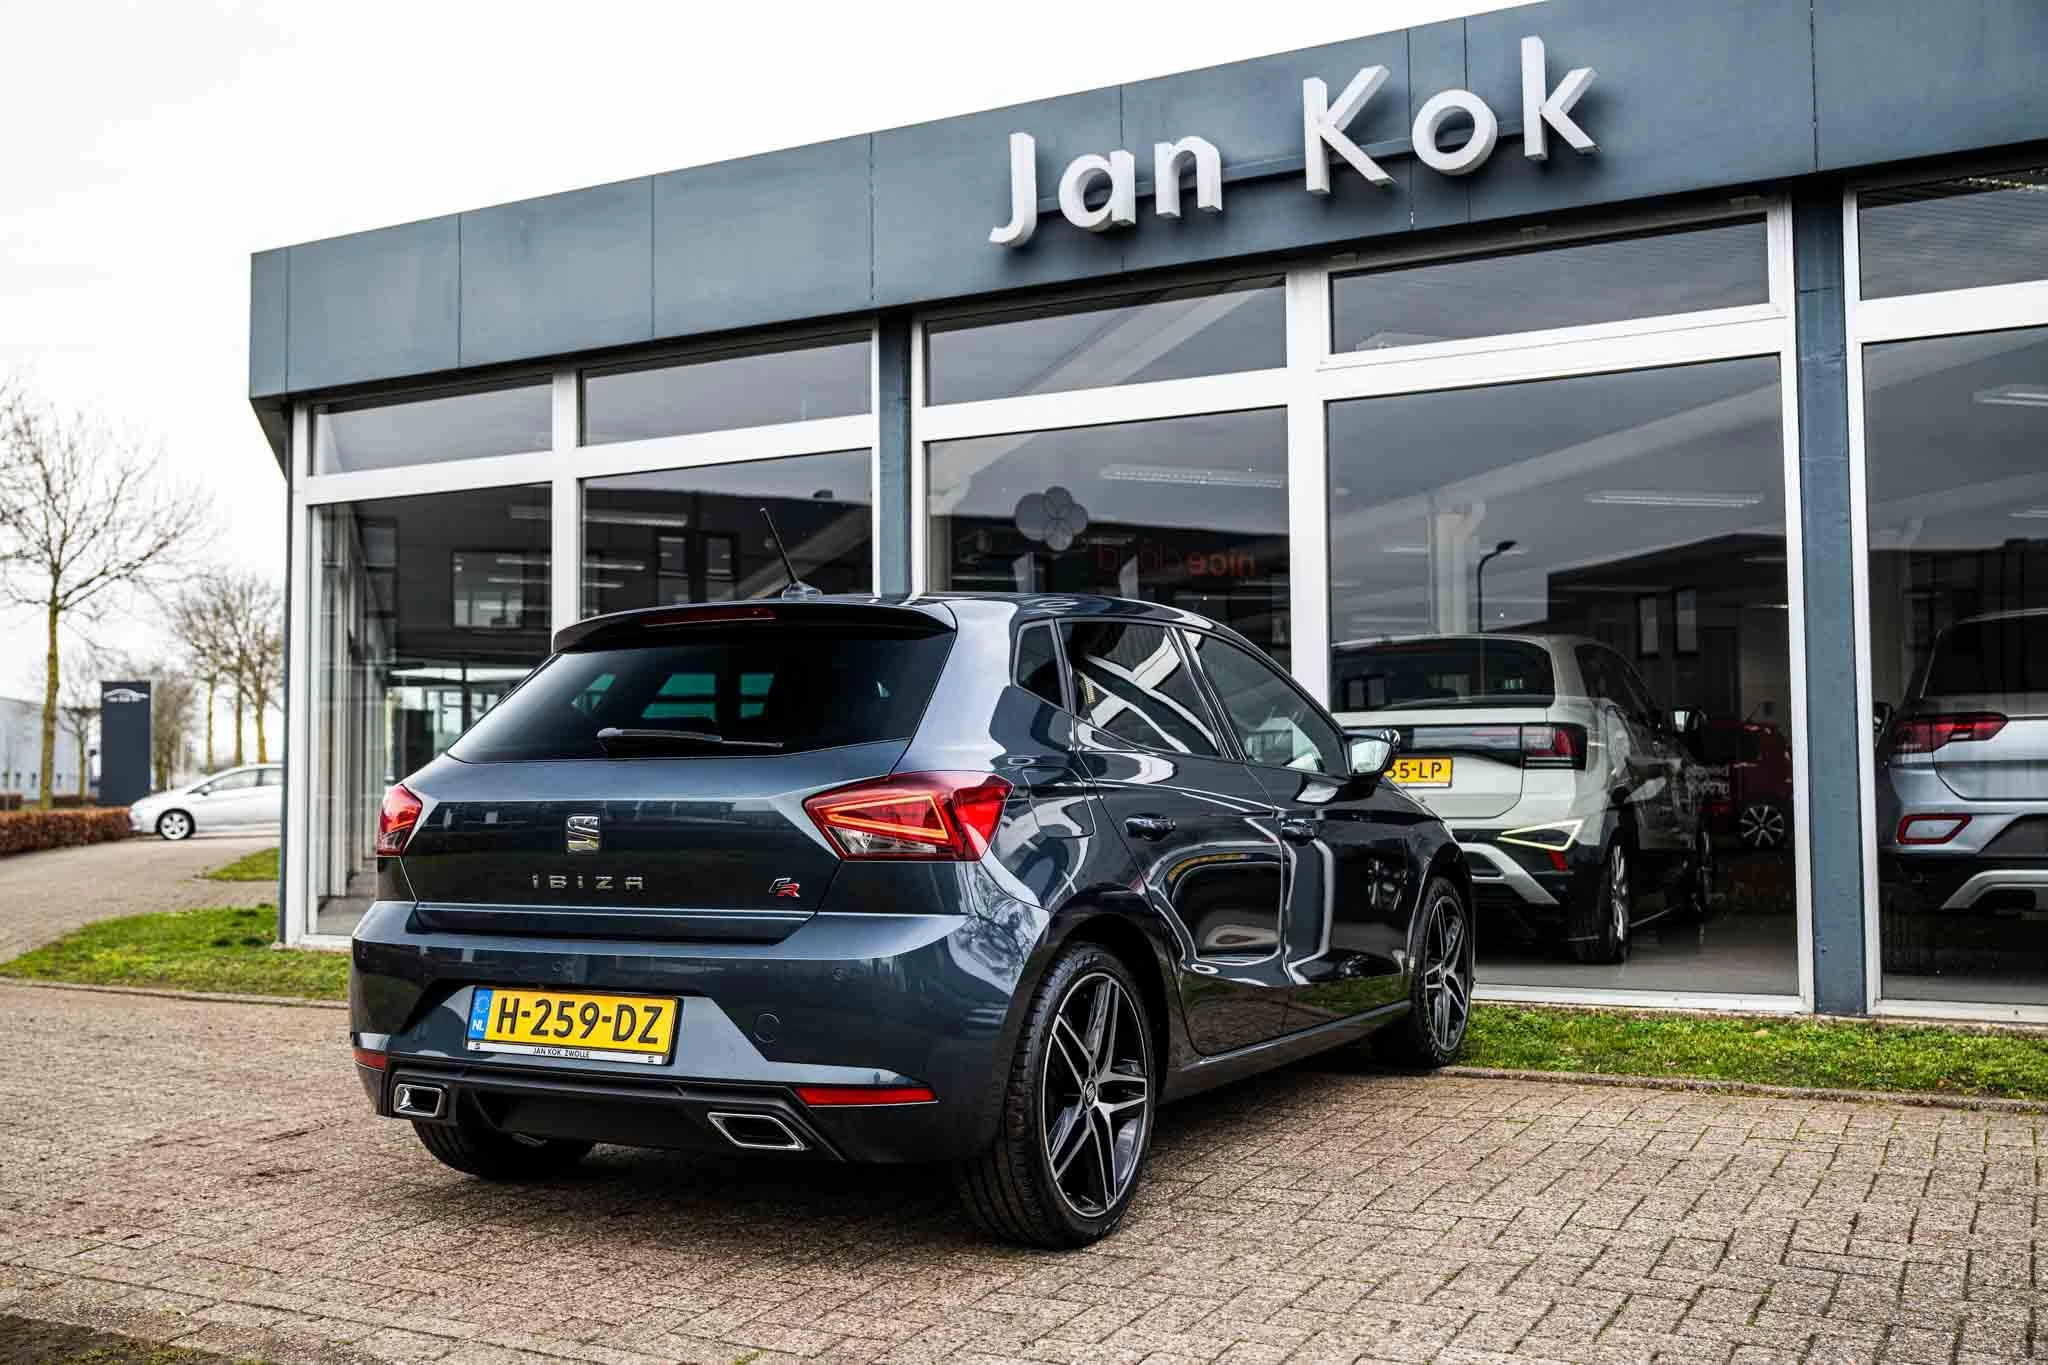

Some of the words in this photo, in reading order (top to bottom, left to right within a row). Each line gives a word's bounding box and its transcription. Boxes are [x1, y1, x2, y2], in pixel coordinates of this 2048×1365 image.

[988, 131, 1223, 247] Jan
[1301, 35, 1600, 195] Kok
[531, 874, 643, 890] IBIZA
[768, 877, 800, 898] FR
[472, 1019, 485, 1032] NL
[496, 997, 664, 1045] H-259-DZ
[532, 1047, 546, 1055] JAN
[547, 1048, 561, 1057] KOK
[564, 1049, 590, 1059] ZWOLLE
